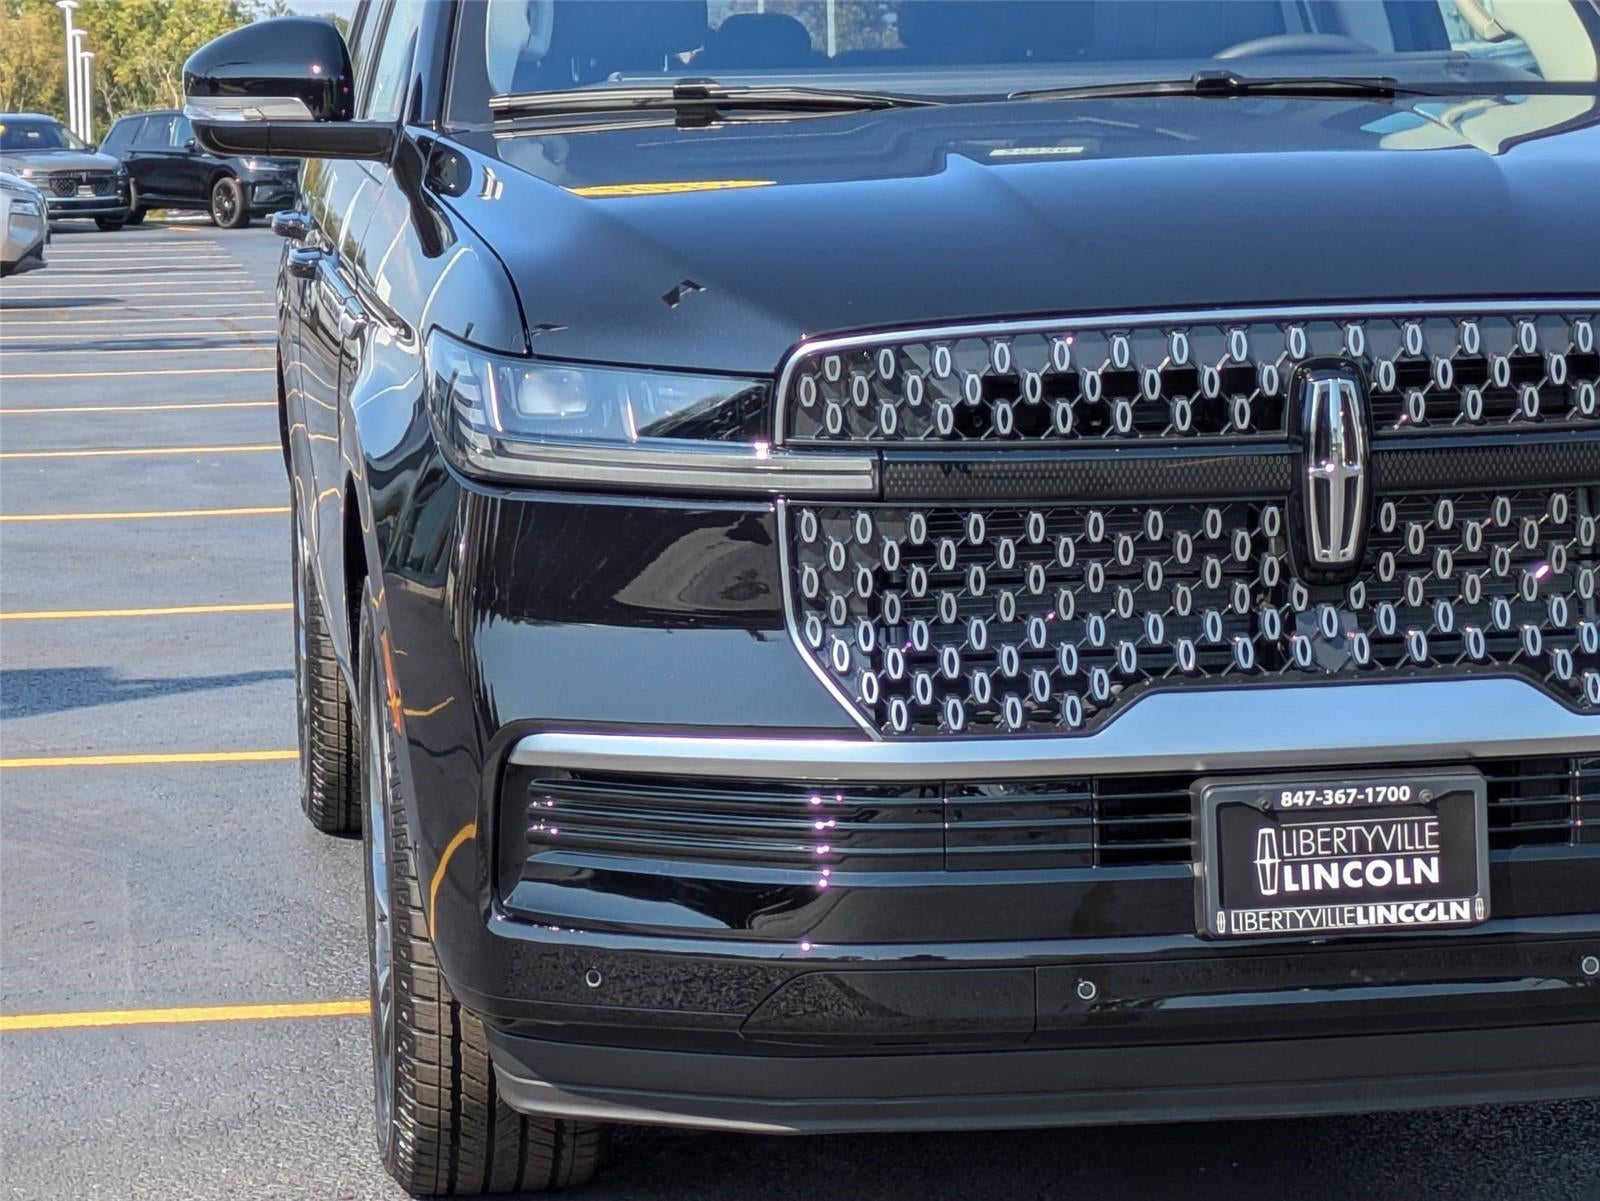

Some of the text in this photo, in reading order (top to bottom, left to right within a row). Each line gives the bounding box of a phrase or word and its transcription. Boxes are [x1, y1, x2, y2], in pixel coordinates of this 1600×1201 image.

[1281, 786, 1410, 807] 847-367-1700
[1282, 822, 1440, 857] LIBERTYVILLE
[1284, 857, 1439, 892] LINCOLN
